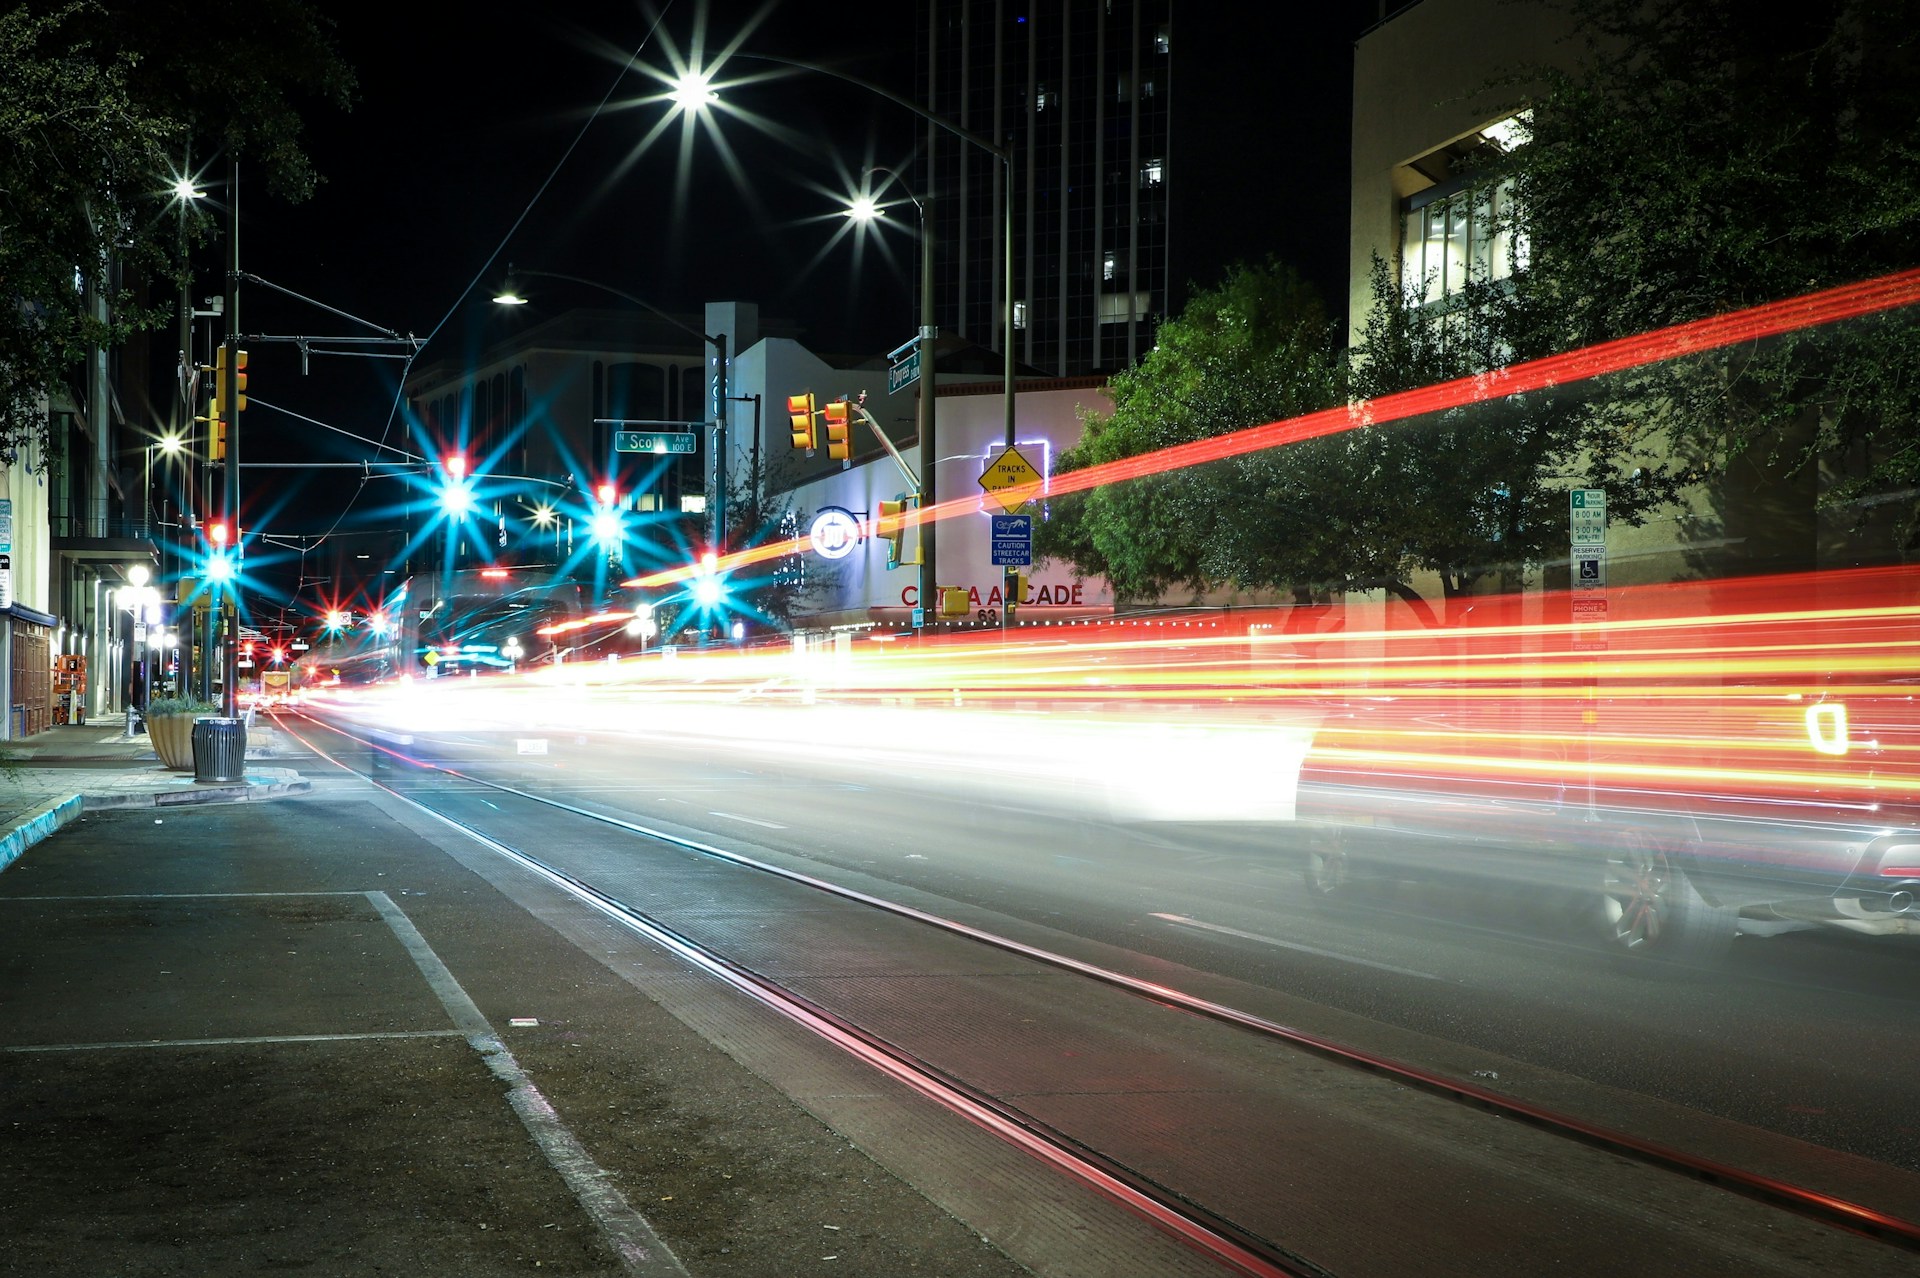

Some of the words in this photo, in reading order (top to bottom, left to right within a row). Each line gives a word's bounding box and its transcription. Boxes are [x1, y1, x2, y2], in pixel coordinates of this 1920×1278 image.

[630, 434, 664, 449] Scot
[675, 435, 690, 443] Ave
[672, 443, 685, 451] 100
[687, 443, 692, 451] E
[998, 465, 1026, 473] TRACKS
[1007, 475, 1015, 483] IN
[1575, 494, 1581, 505] 2
[1592, 510, 1602, 518] AM
[1592, 526, 1602, 534] PM
[999, 557, 1025, 565] TRACKS
[987, 584, 1082, 605] ACADE
[977, 609, 997, 621] 63
